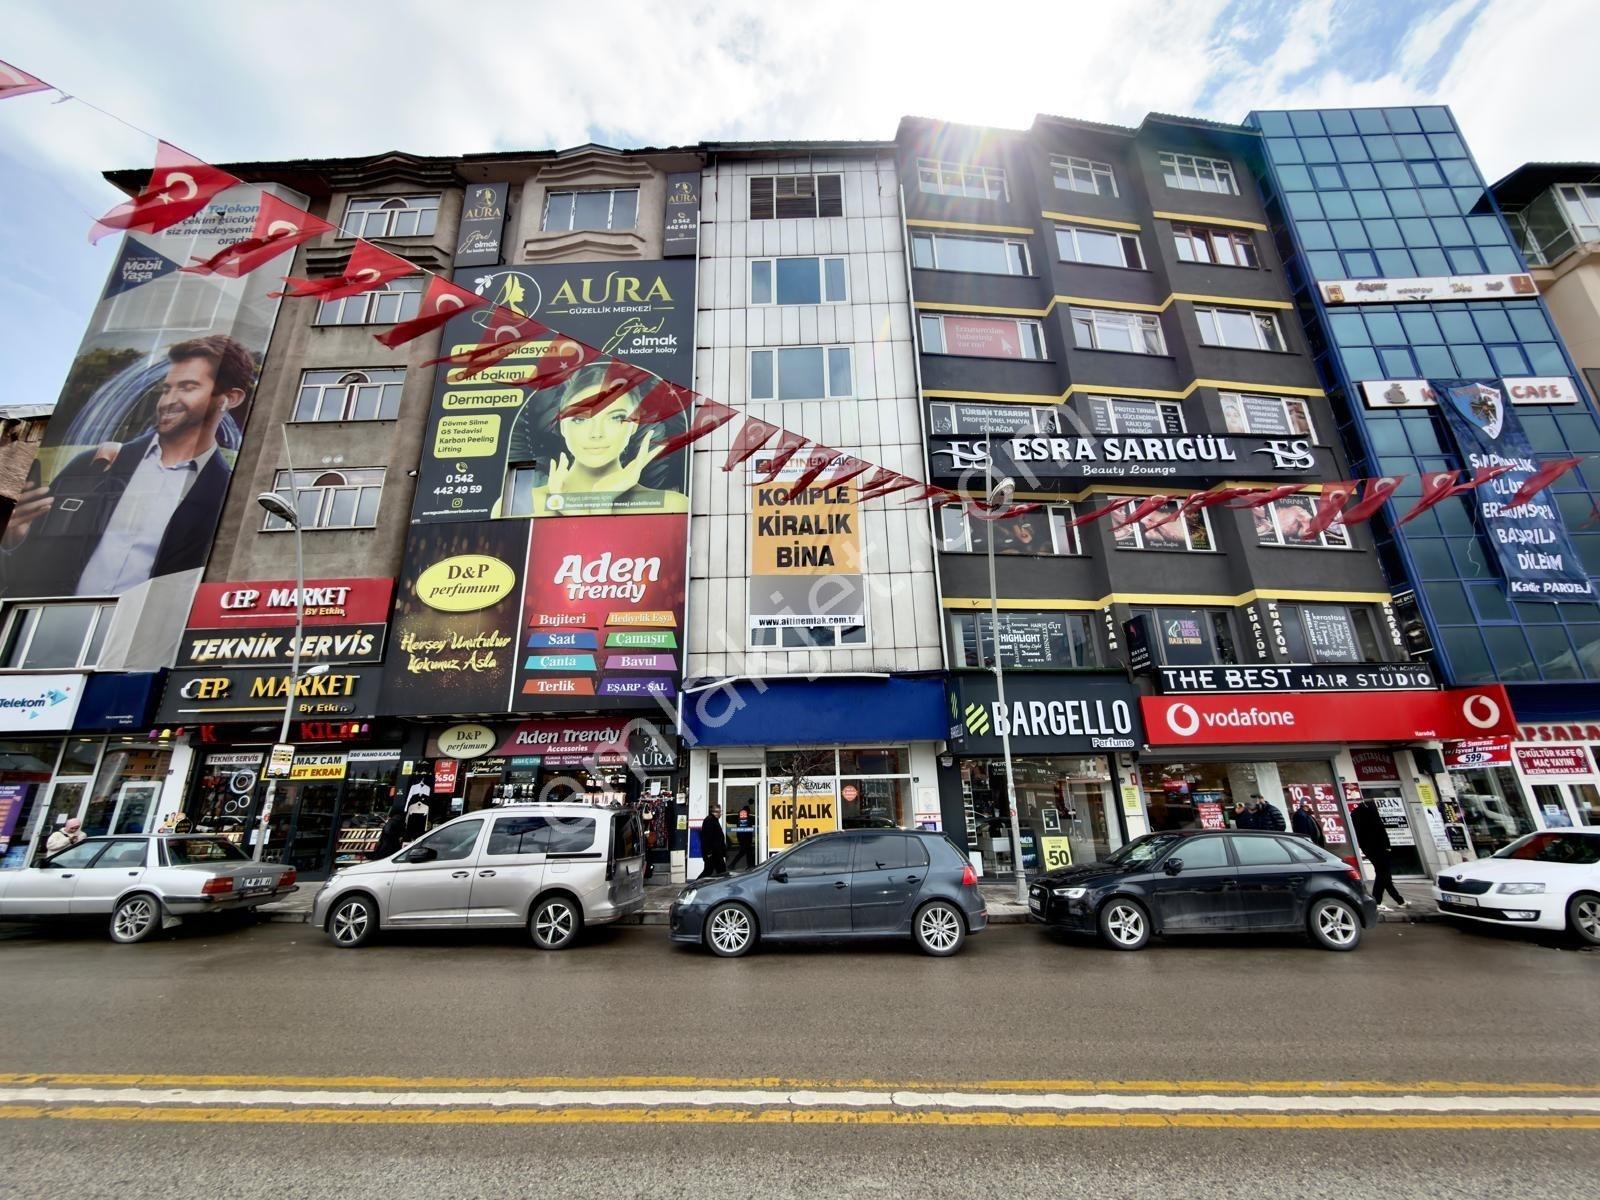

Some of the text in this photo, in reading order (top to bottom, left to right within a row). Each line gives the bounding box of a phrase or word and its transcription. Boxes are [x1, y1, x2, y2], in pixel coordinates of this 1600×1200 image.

[464, 207, 501, 218] AURA
[123, 260, 164, 271] Mobil
[122, 271, 153, 282] Yaşa
[549, 271, 674, 305] AURA
[569, 304, 652, 316] GÜZELLİK MERKEZİ
[632, 334, 678, 346] olmak
[617, 346, 678, 356] bu kadar kolay
[481, 369, 526, 381] bakımı
[1511, 384, 1562, 399] CAFE
[448, 393, 518, 406] Dermapen
[442, 418, 489, 427] Dövme Silme
[440, 436, 494, 444] Karbon Peeling
[438, 446, 462, 454] Lifting
[1010, 438, 1096, 462] ESRA
[1103, 434, 1237, 462] SARIGÜL
[1082, 464, 1176, 476] Beauty Lounge
[446, 474, 474, 484] 0 542
[433, 485, 482, 496] 442 49 59
[758, 485, 850, 507] KOMPLE
[758, 510, 852, 536] KİRALIK
[776, 540, 835, 568] BİNA
[447, 563, 490, 580] D&P
[554, 552, 661, 585] Aden
[266, 586, 352, 608] MARKET
[430, 582, 501, 599] perfumum
[566, 580, 646, 603] Trendy
[539, 613, 586, 628] Bujiteri
[548, 633, 576, 646] Saat
[615, 633, 670, 647] Çamaşır
[1000, 634, 1040, 642] HIGHLIGHT
[190, 630, 375, 661] TEKNİK SERVİS
[462, 650, 498, 671] Asla
[540, 656, 577, 669] Çanta
[621, 655, 658, 668] Bavul
[1163, 668, 1431, 689] THE BEST HAIR STUDIO
[250, 674, 361, 698] MARKET
[537, 680, 576, 692] Terlik
[606, 682, 641, 694] EŞARP
[647, 681, 668, 692] ŞAL
[300, 703, 314, 714] By
[991, 700, 1132, 736] BARGELLO
[1203, 708, 1296, 727] vodafone
[456, 731, 482, 742] D&P
[516, 726, 620, 745] Aden Trendy
[446, 742, 488, 752] perfumum
[546, 744, 588, 753] Accessories
[1092, 738, 1134, 748] Perfume
[210, 754, 259, 763] TEKNİK SERVİS
[631, 752, 674, 766] AURA
[1464, 753, 1482, 763] 599
[1525, 748, 1576, 758] KÜLTÜR KAFE
[320, 756, 342, 764] CAM
[1533, 758, 1576, 767] MAÇ YAYINI
[310, 768, 342, 777] EKRAN
[434, 774, 454, 782] %50
[1289, 786, 1304, 801] 10
[1314, 786, 1325, 800] 5
[771, 800, 832, 820] KİRALIK
[1321, 818, 1336, 832] 20
[1048, 850, 1070, 866] 50
